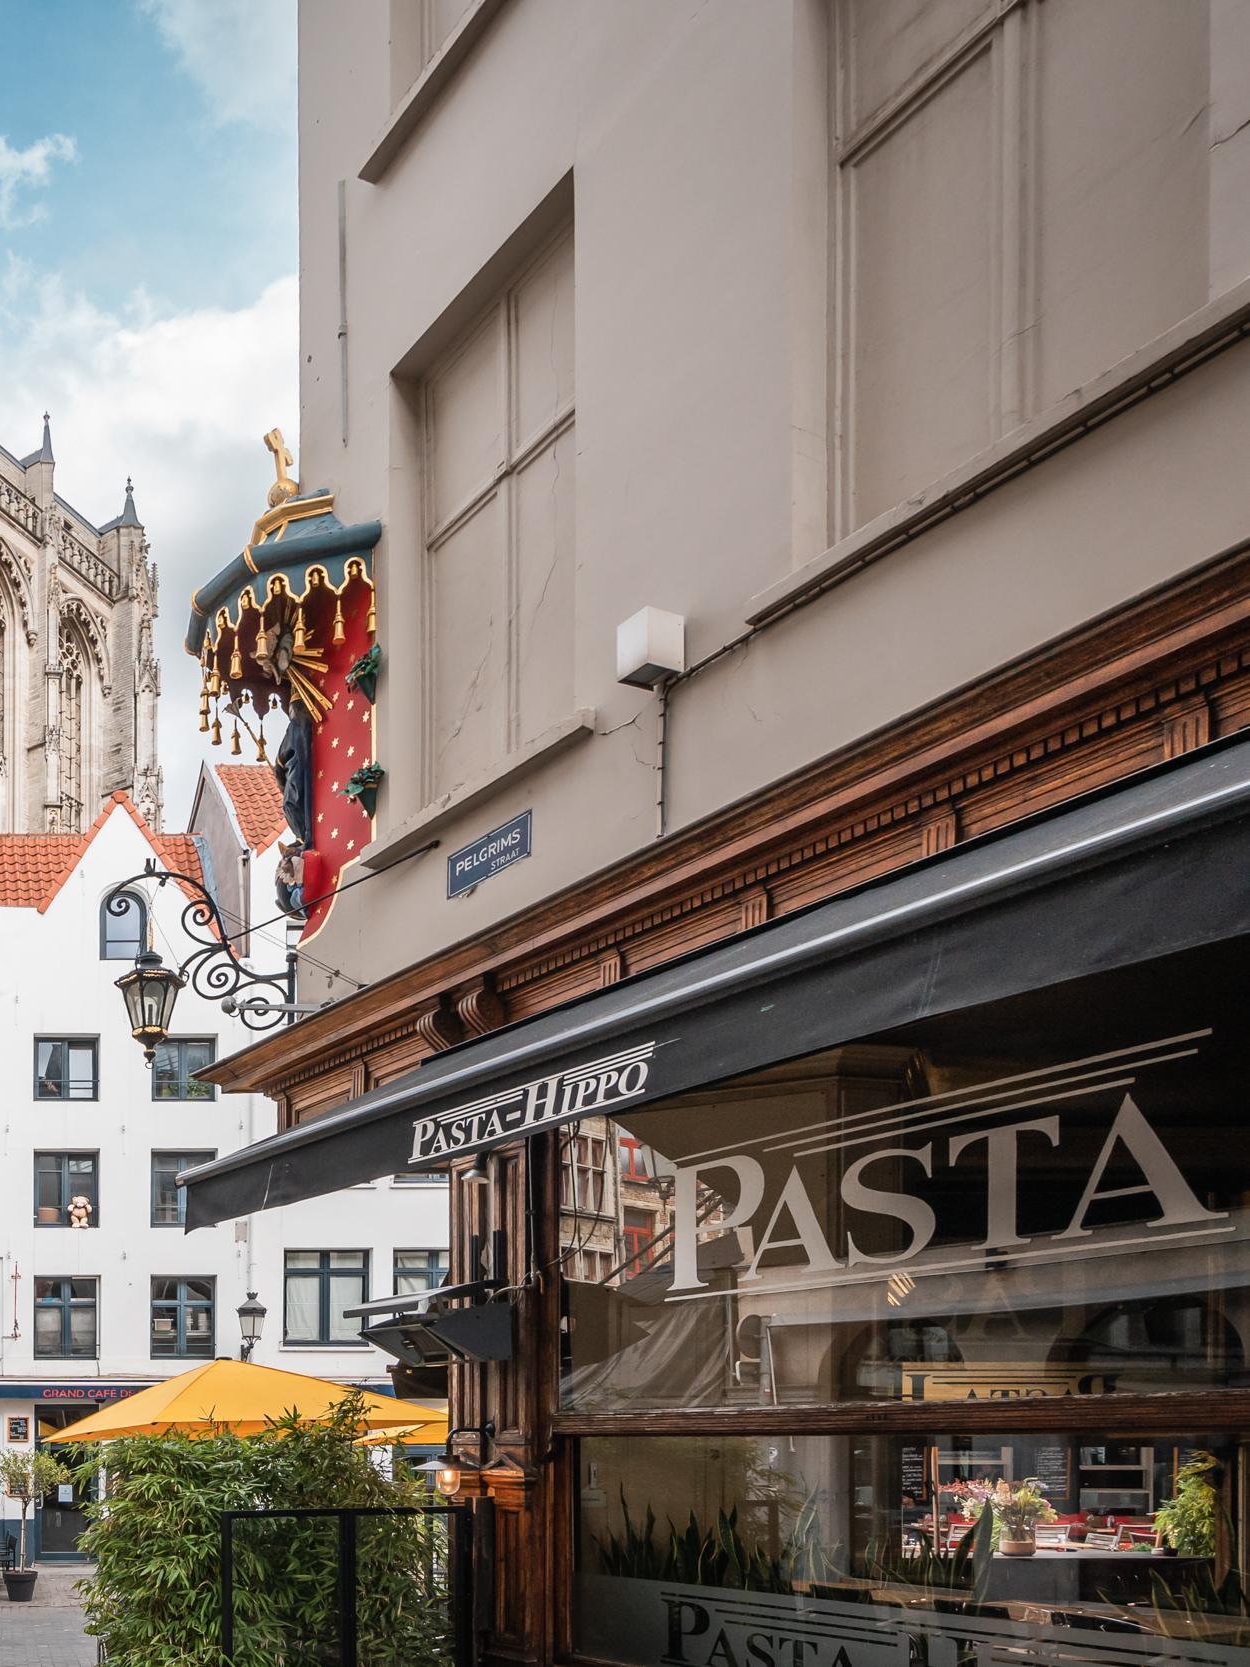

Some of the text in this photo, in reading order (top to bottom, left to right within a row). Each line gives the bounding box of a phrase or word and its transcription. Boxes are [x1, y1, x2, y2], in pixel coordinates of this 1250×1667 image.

[455, 828, 521, 876] PELGRIMS
[490, 848, 520, 871] STRAAT
[409, 1061, 649, 1161] PASTA-HIPPO
[667, 1092, 1230, 1291] PASTA
[43, 1389, 85, 1398] GRAND
